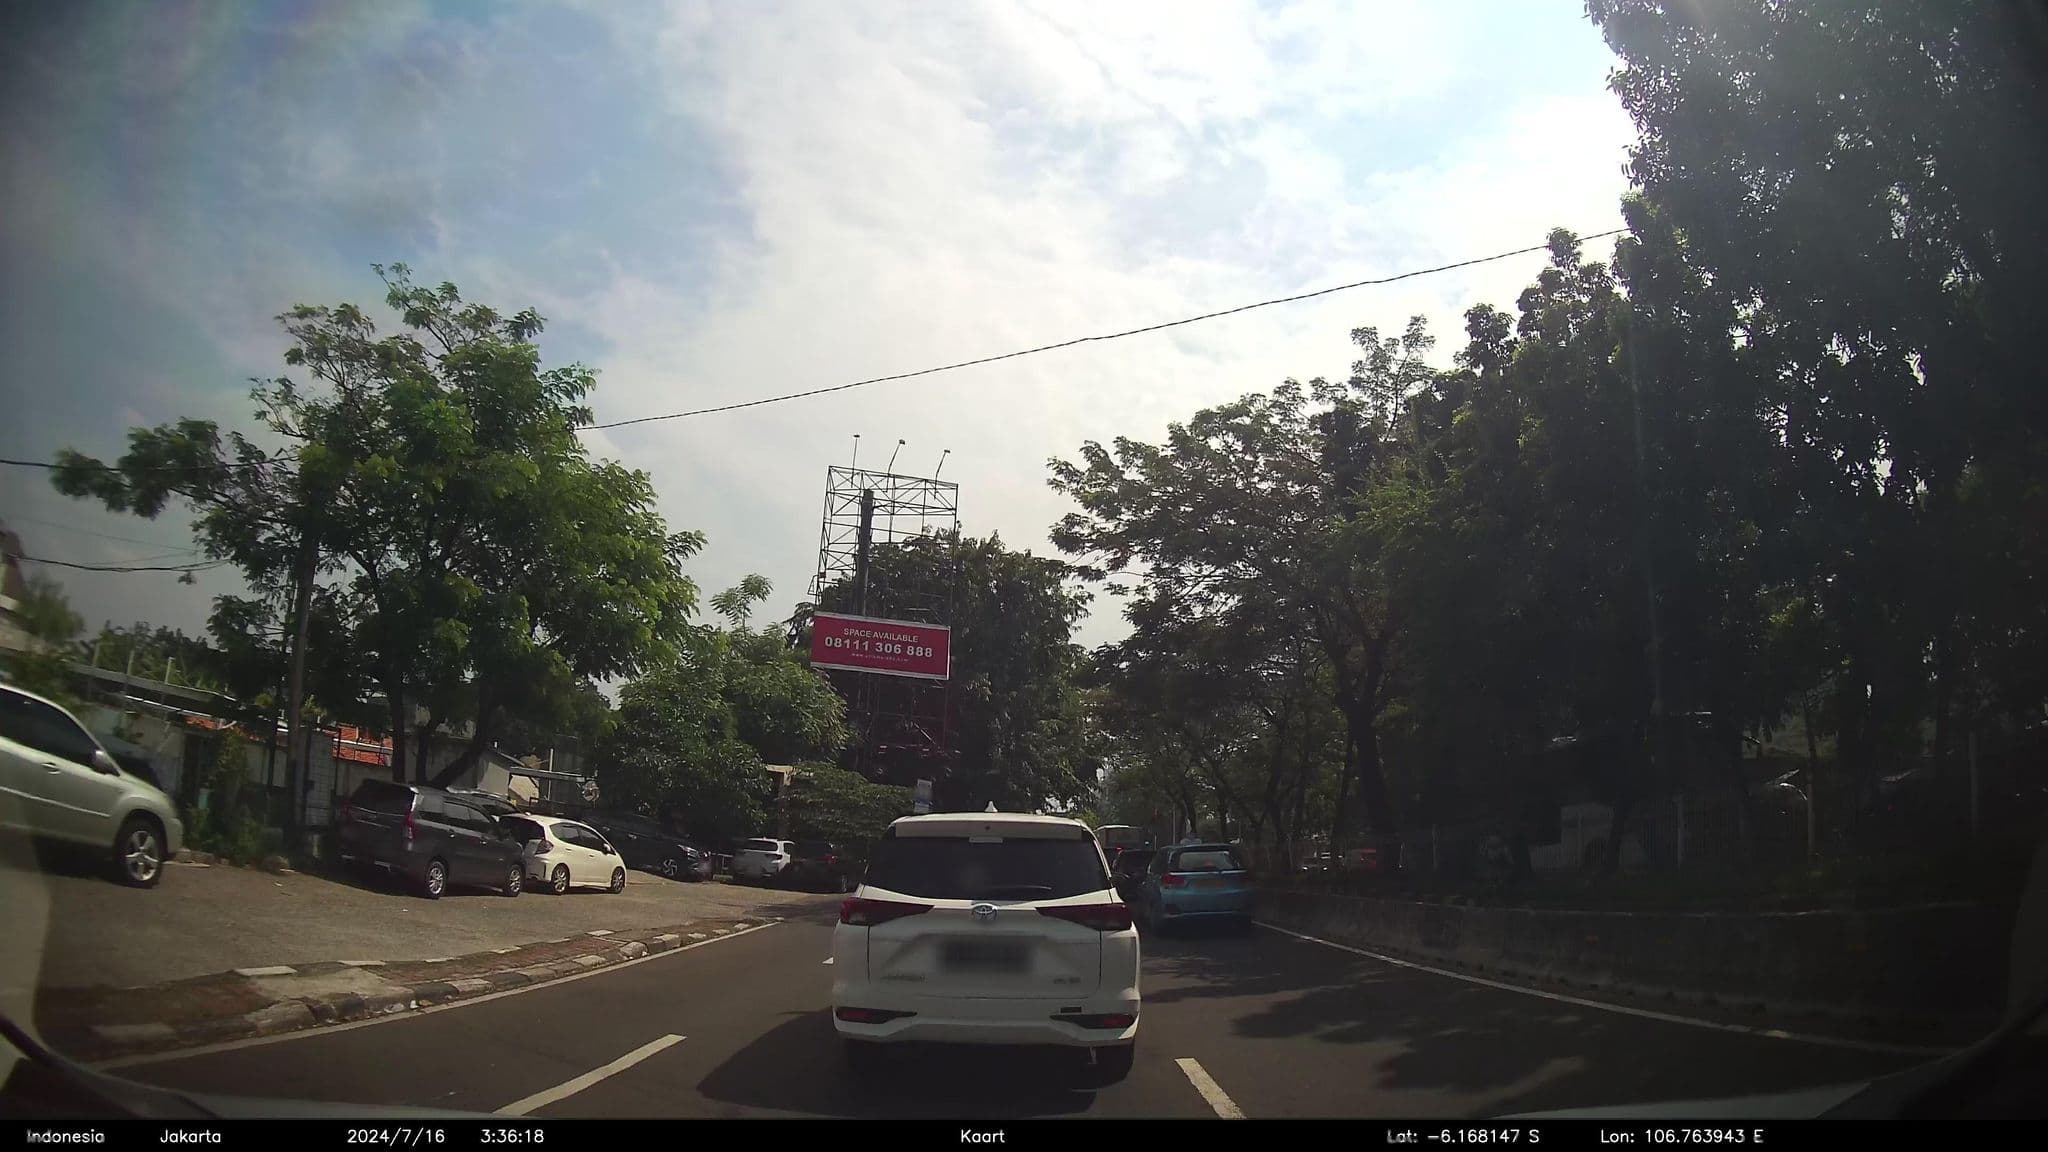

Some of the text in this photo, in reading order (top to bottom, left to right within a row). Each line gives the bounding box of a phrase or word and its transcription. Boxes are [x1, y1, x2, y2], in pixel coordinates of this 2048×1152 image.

[844, 628, 919, 643] SPACE AVAILABLE
[824, 636, 869, 651] 08111
[875, 642, 902, 655] 306
[907, 646, 934, 658] 888
